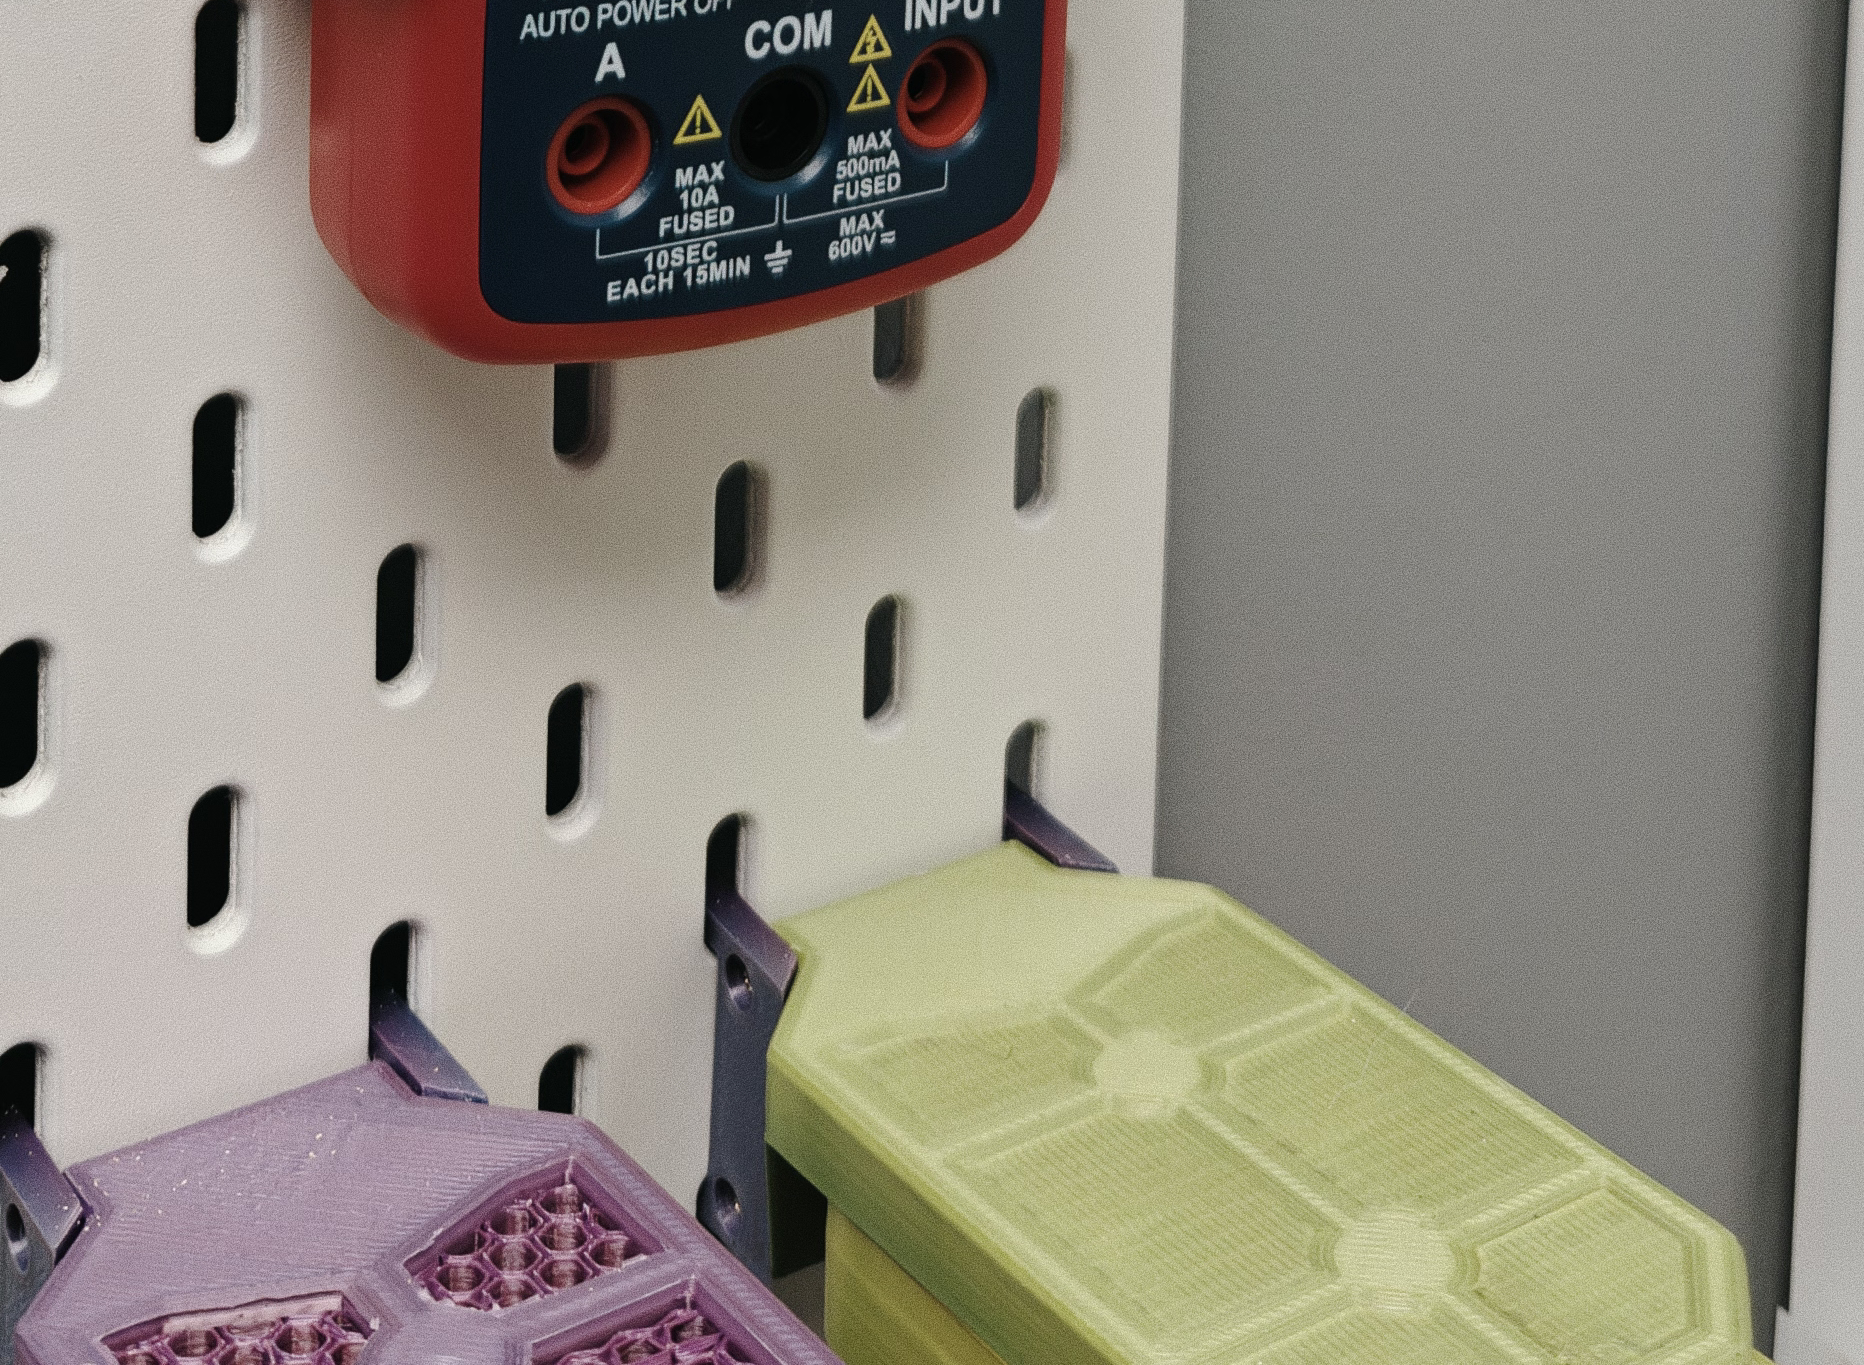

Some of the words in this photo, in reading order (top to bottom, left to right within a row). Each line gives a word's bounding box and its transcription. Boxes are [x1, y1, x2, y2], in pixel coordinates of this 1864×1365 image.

[519, 6, 590, 41] AUTO
[744, 9, 833, 60] COM
[594, 41, 626, 83] A
[847, 128, 893, 156] MAX
[674, 160, 726, 190] MAX
[835, 149, 901, 181] 500mA
[679, 184, 719, 211] 10A
[832, 172, 902, 205] FUSED
[658, 205, 735, 239] FUSED
[839, 209, 885, 238] MAX
[643, 240, 718, 273] 10SEC
[828, 231, 877, 262] 600V
[606, 270, 675, 304] EACH
[682, 254, 751, 288] 15MIN
